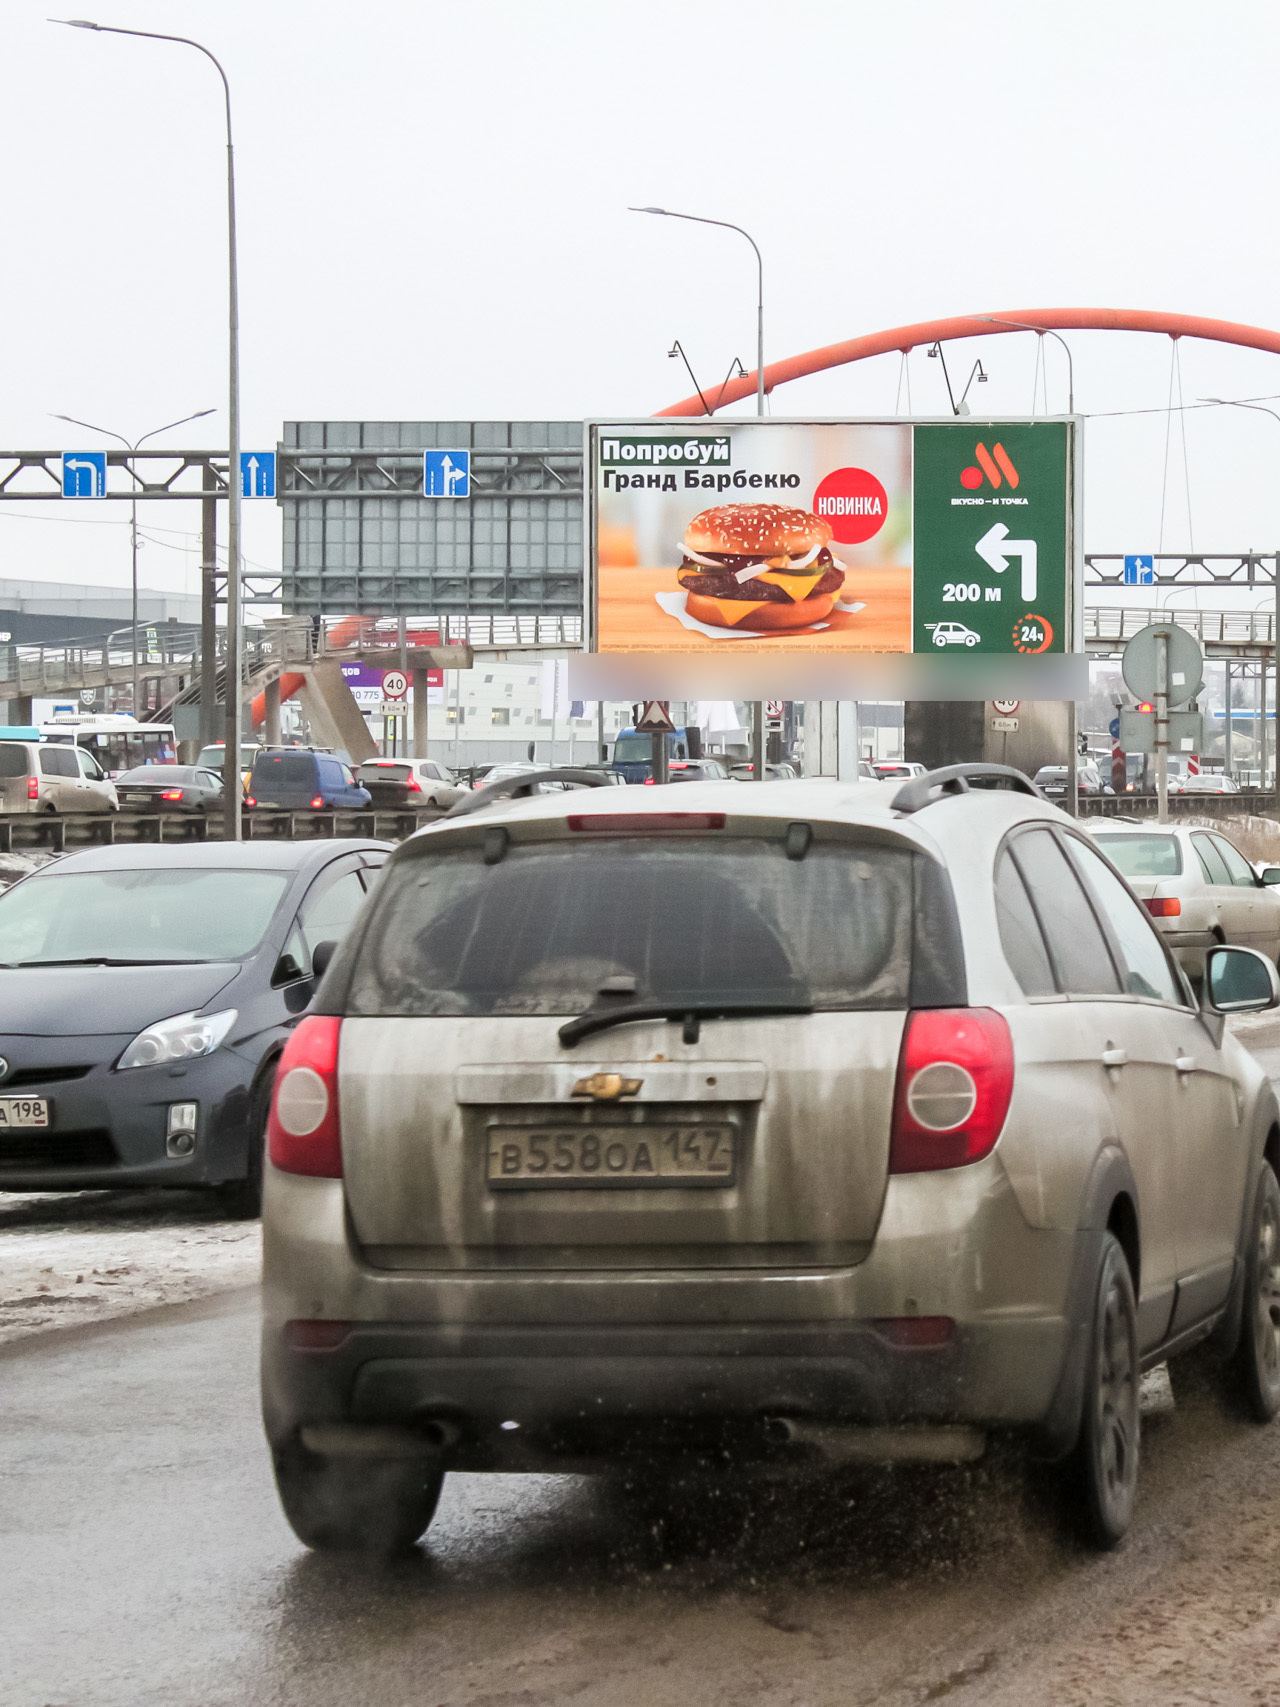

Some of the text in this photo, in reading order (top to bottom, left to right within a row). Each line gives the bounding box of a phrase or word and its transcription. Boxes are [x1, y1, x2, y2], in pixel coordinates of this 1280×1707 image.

[602, 438, 729, 464] Попробуй
[603, 470, 801, 492] Гранд Барбекю
[818, 496, 883, 515] НОВИНКА
[942, 583, 981, 602] 200
[387, 679, 403, 690] 40
[363, 691, 379, 699] 775
[12, 1102, 42, 1118] 198
[501, 1130, 722, 1174] В558ОА 147
